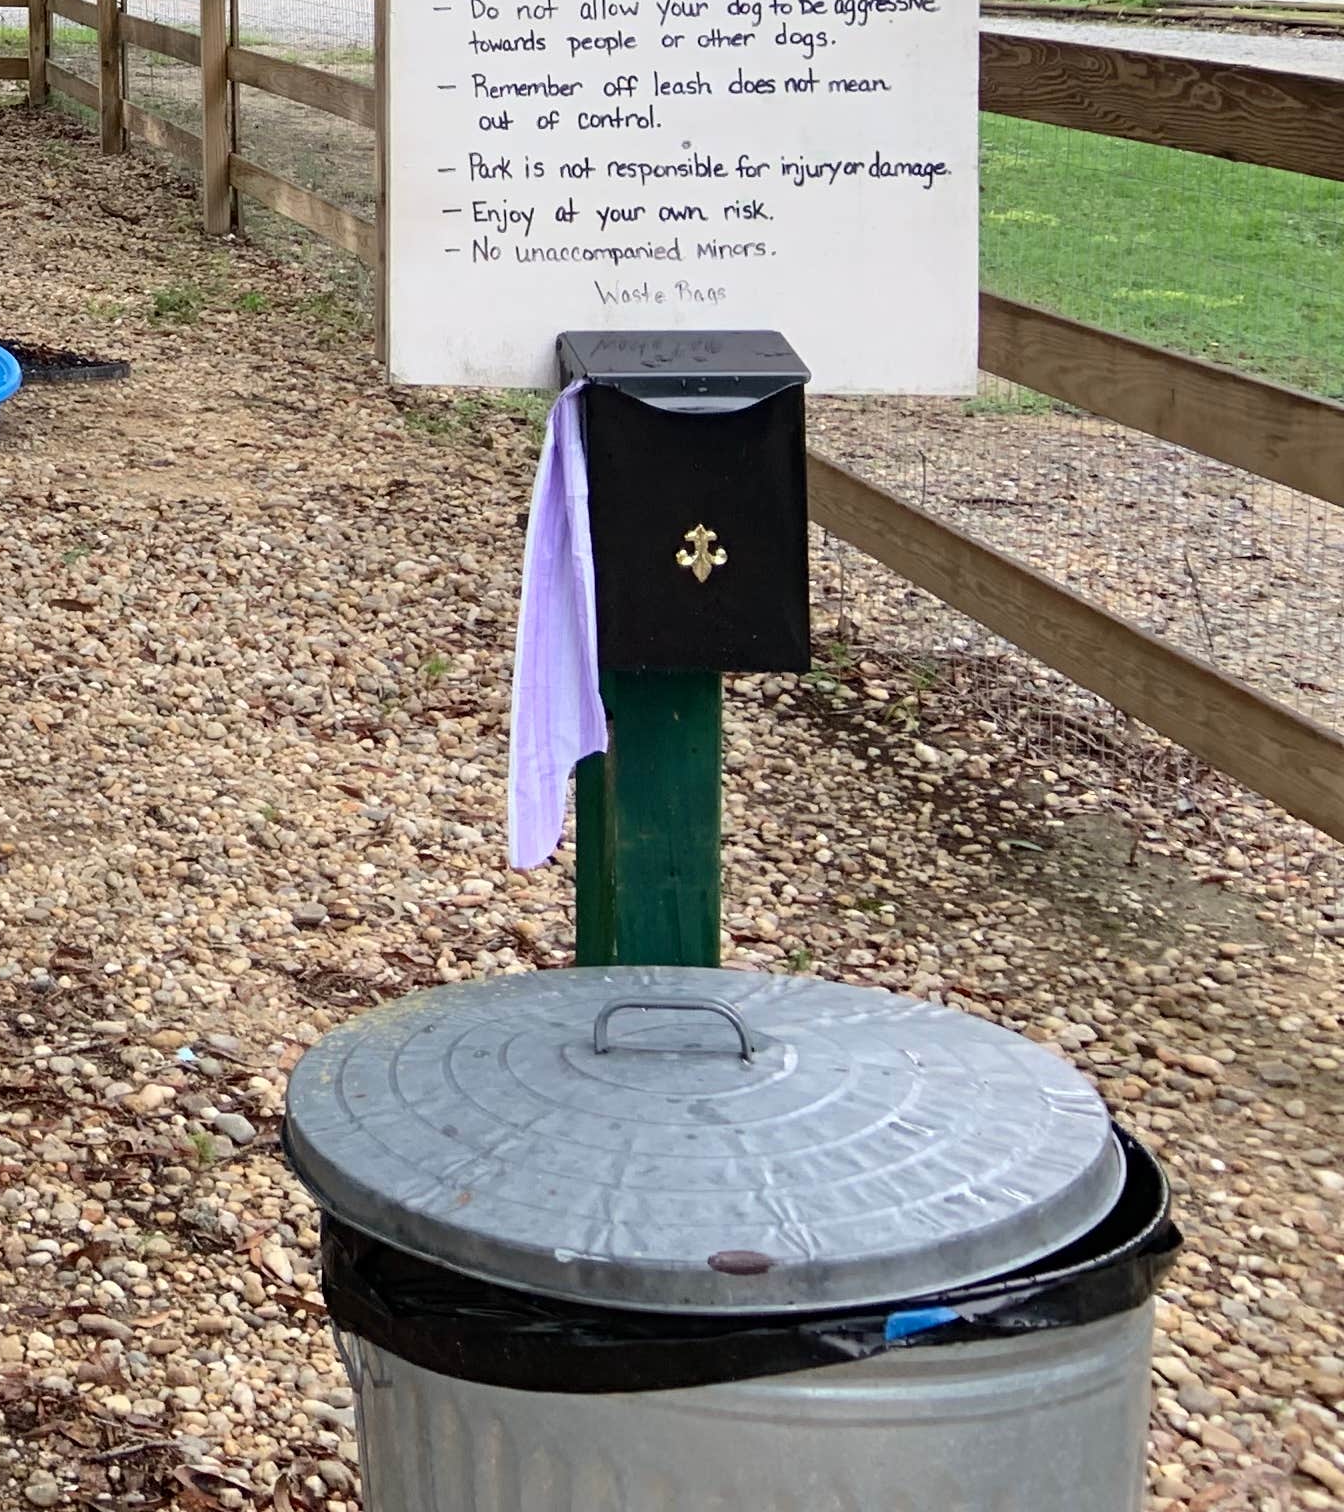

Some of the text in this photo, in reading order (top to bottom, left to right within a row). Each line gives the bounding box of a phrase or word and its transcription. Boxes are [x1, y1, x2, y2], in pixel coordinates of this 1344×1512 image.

[656, 0, 709, 26] your
[468, 22, 836, 60] towards people or other dogs.
[471, 73, 583, 99] Remember
[603, 75, 639, 98] off
[654, 71, 712, 96] leash
[728, 67, 776, 94] does
[784, 67, 820, 93] not
[479, 104, 661, 131] out of control.
[468, 150, 952, 190] Park is not responsible for injury or damage.
[472, 197, 774, 237] Enjoy at your own risk.
[473, 235, 501, 263] No
[515, 237, 683, 267] unaccompanied
[594, 280, 666, 304] Waste
